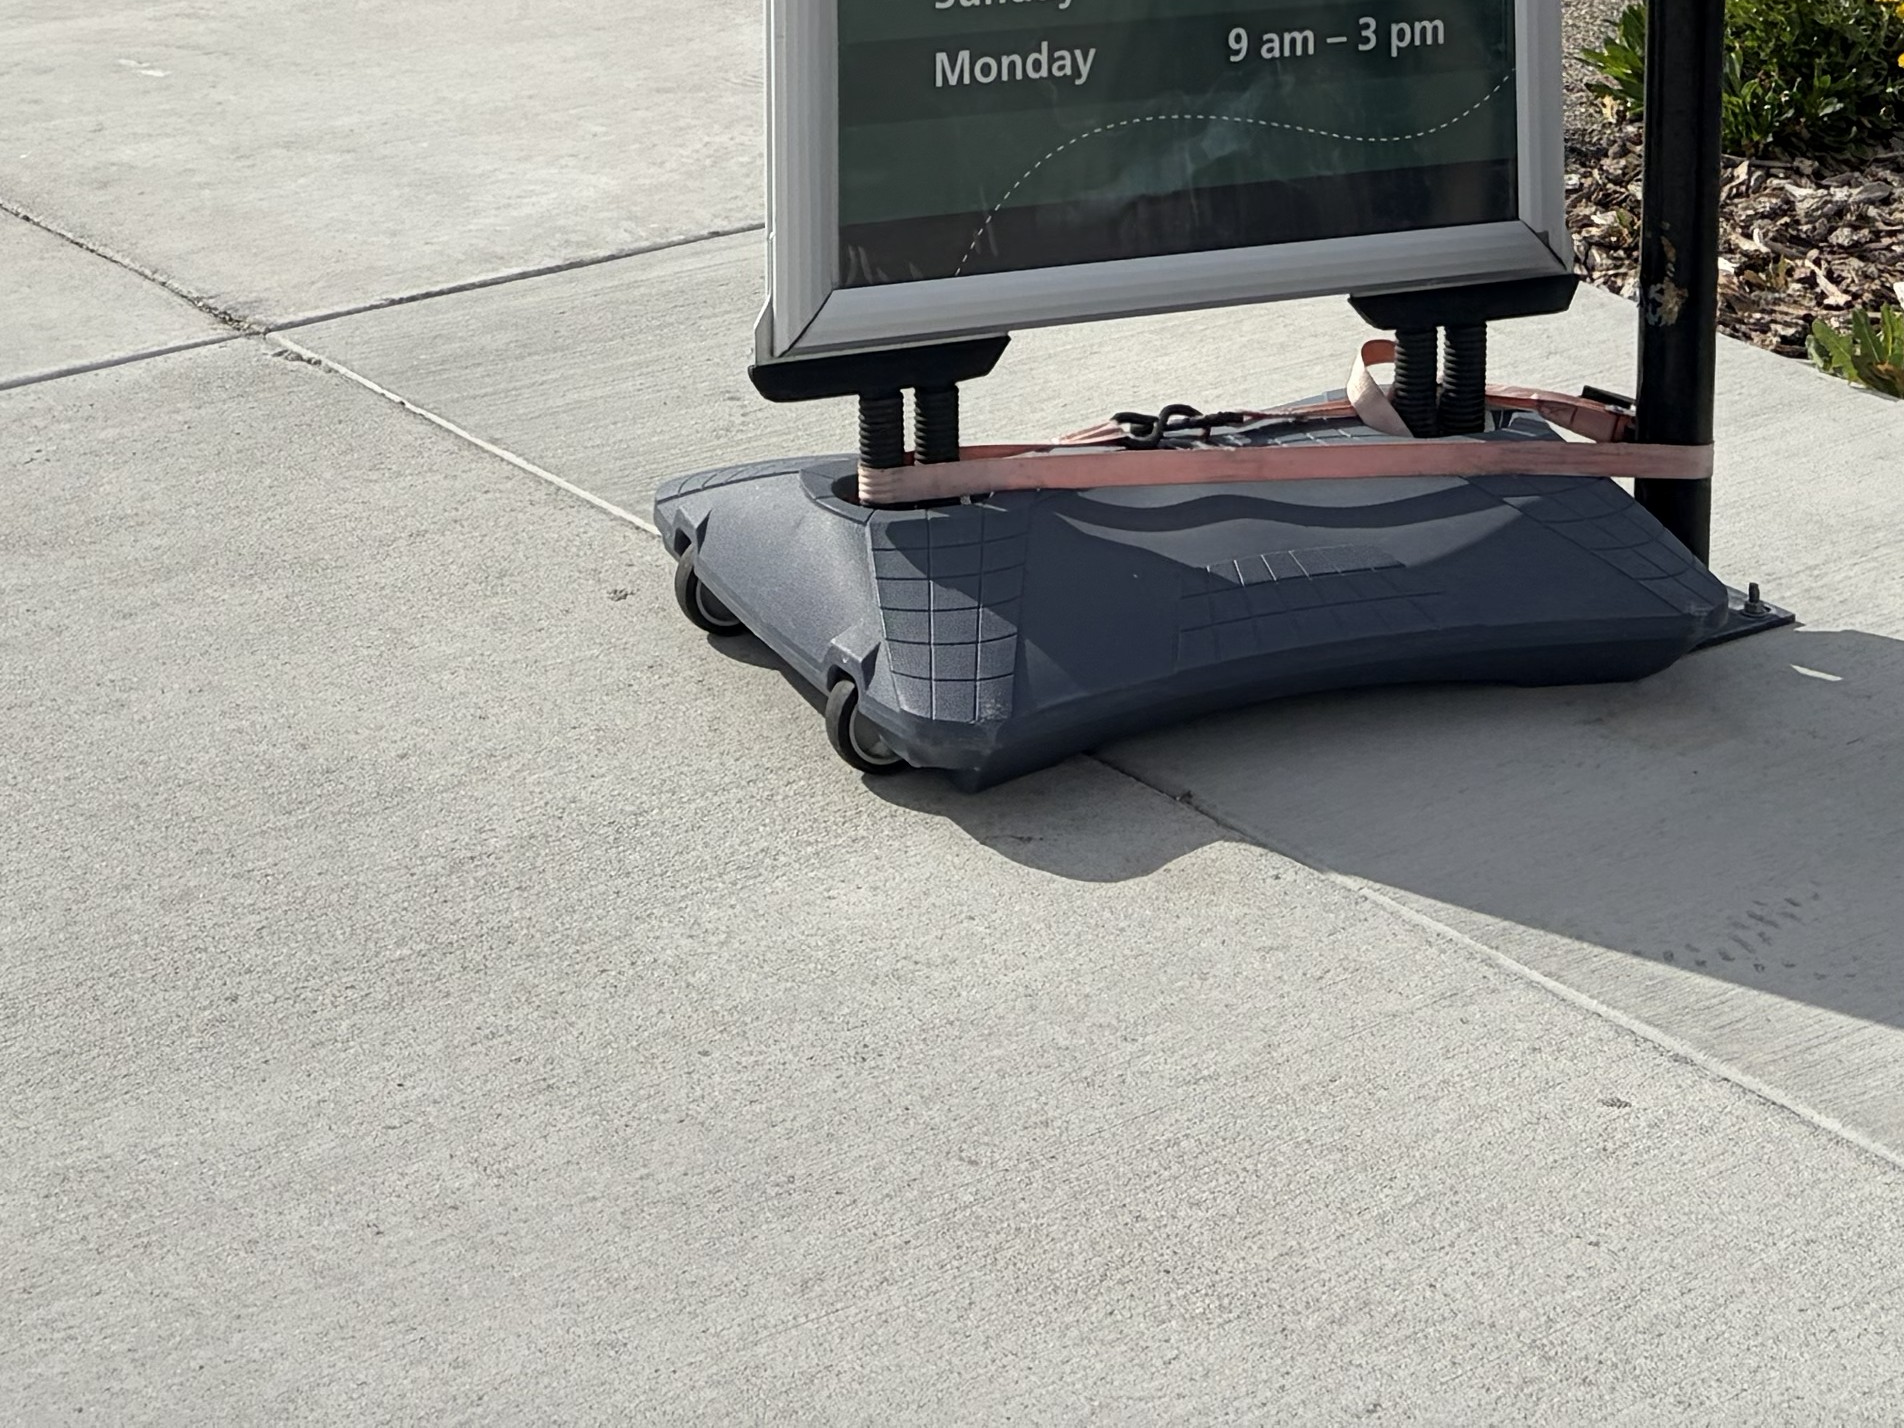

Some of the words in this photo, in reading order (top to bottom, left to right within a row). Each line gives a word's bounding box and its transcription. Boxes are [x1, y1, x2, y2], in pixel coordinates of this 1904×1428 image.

[935, 44, 1096, 88] Monday
[1228, 27, 1249, 62] 9
[1260, 29, 1315, 59] am
[1358, 17, 1377, 51] 3
[1390, 19, 1445, 58] pm
